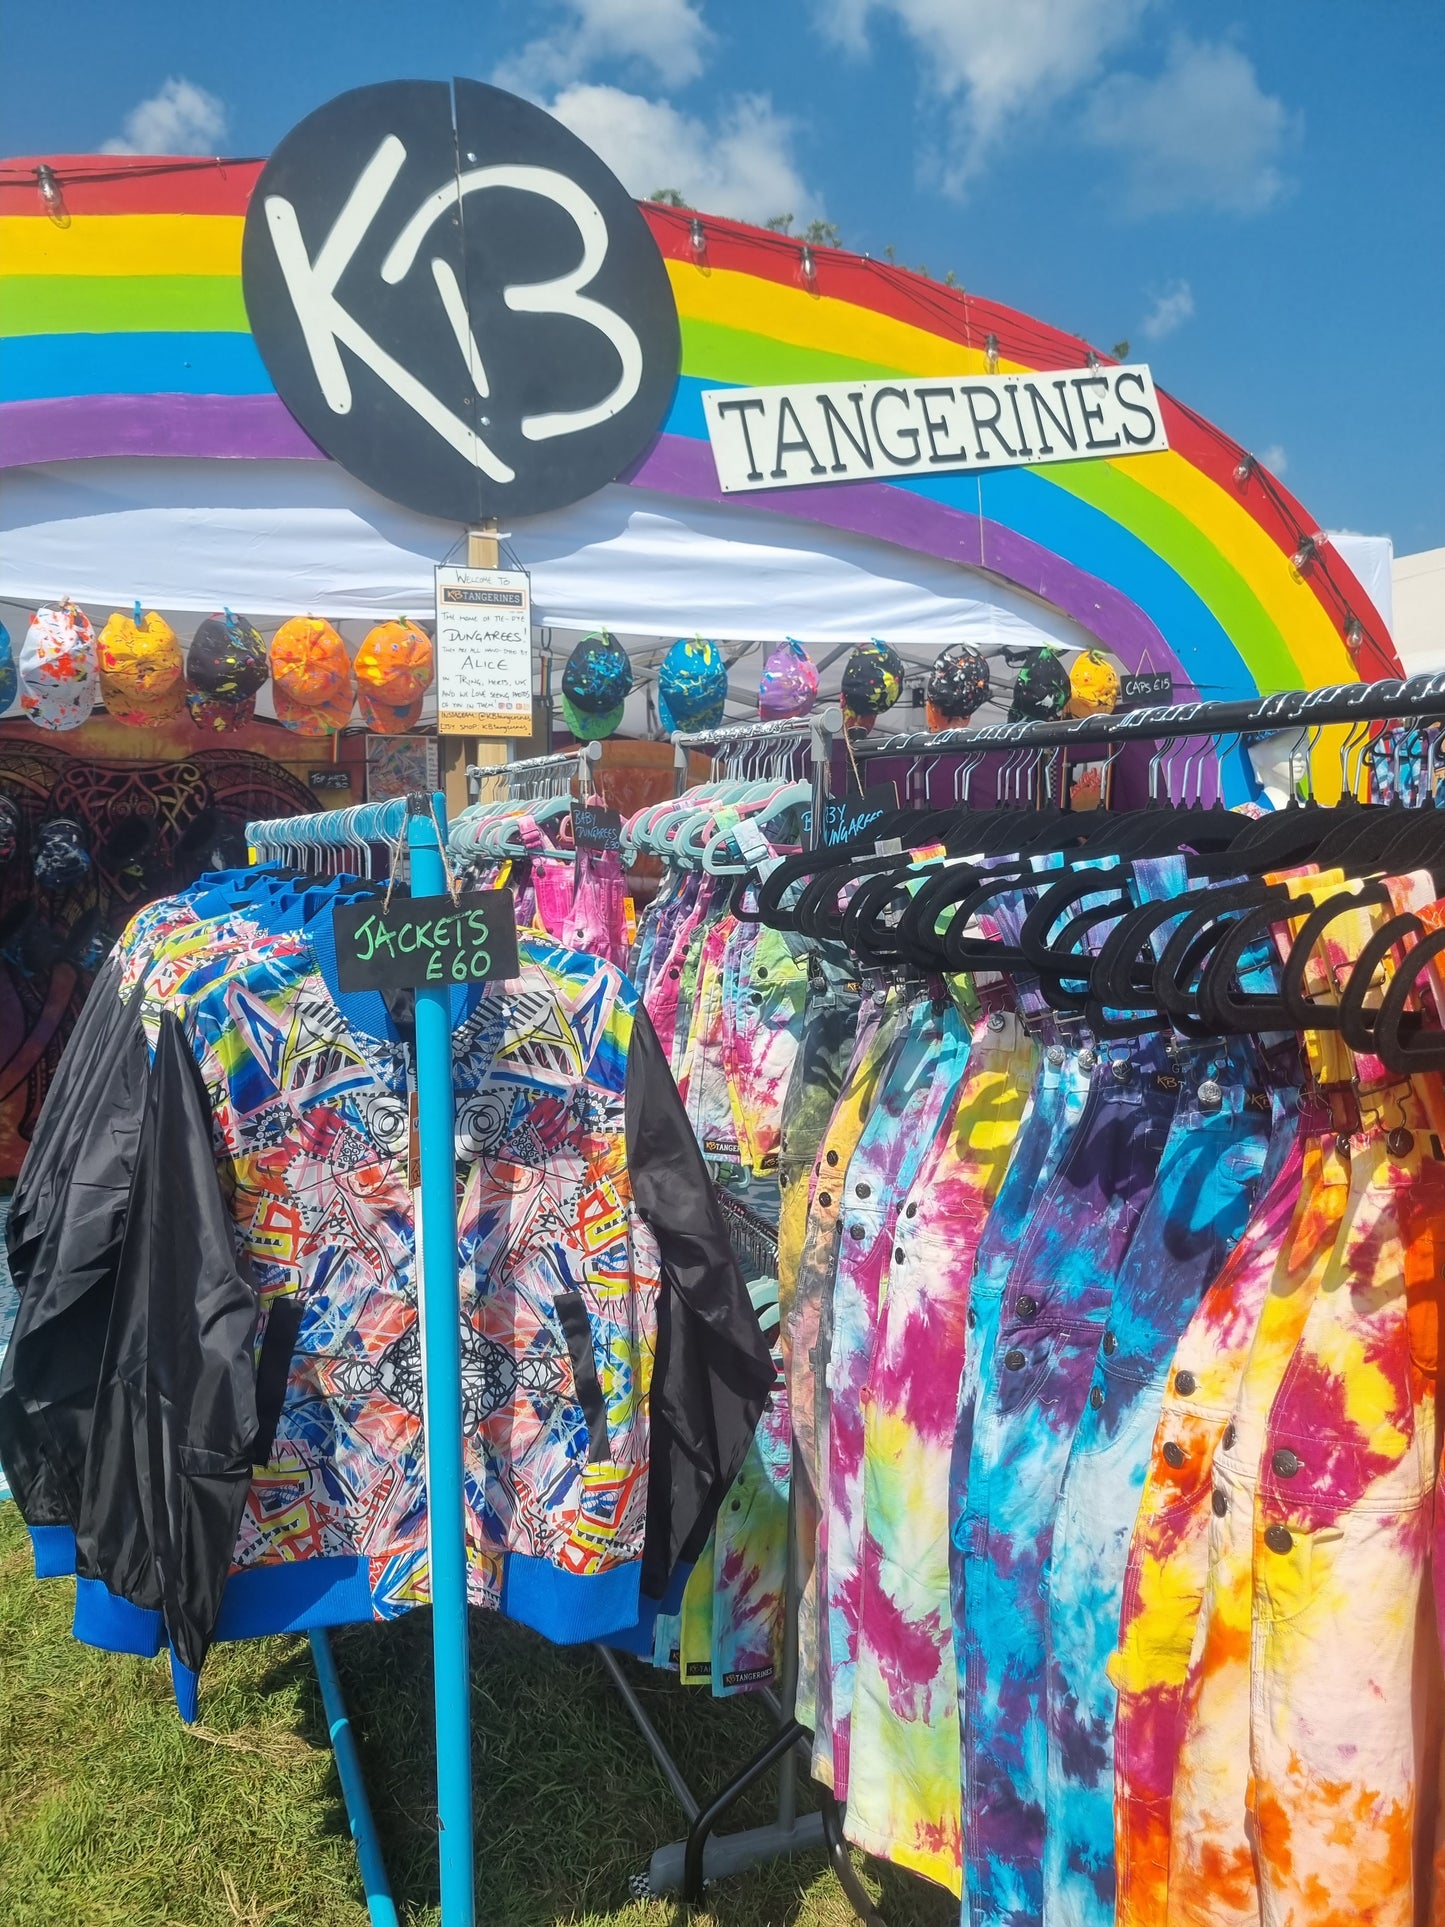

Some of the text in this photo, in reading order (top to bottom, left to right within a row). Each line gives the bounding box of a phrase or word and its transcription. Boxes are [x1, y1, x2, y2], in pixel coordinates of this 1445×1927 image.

[264, 133, 643, 484] KB
[718, 372, 1156, 482] TANGERINES
[1125, 681, 1152, 696] CAPS
[573, 809, 597, 827] BABY
[575, 826, 618, 841] DUNGAREES
[354, 909, 490, 961] JACKETS
